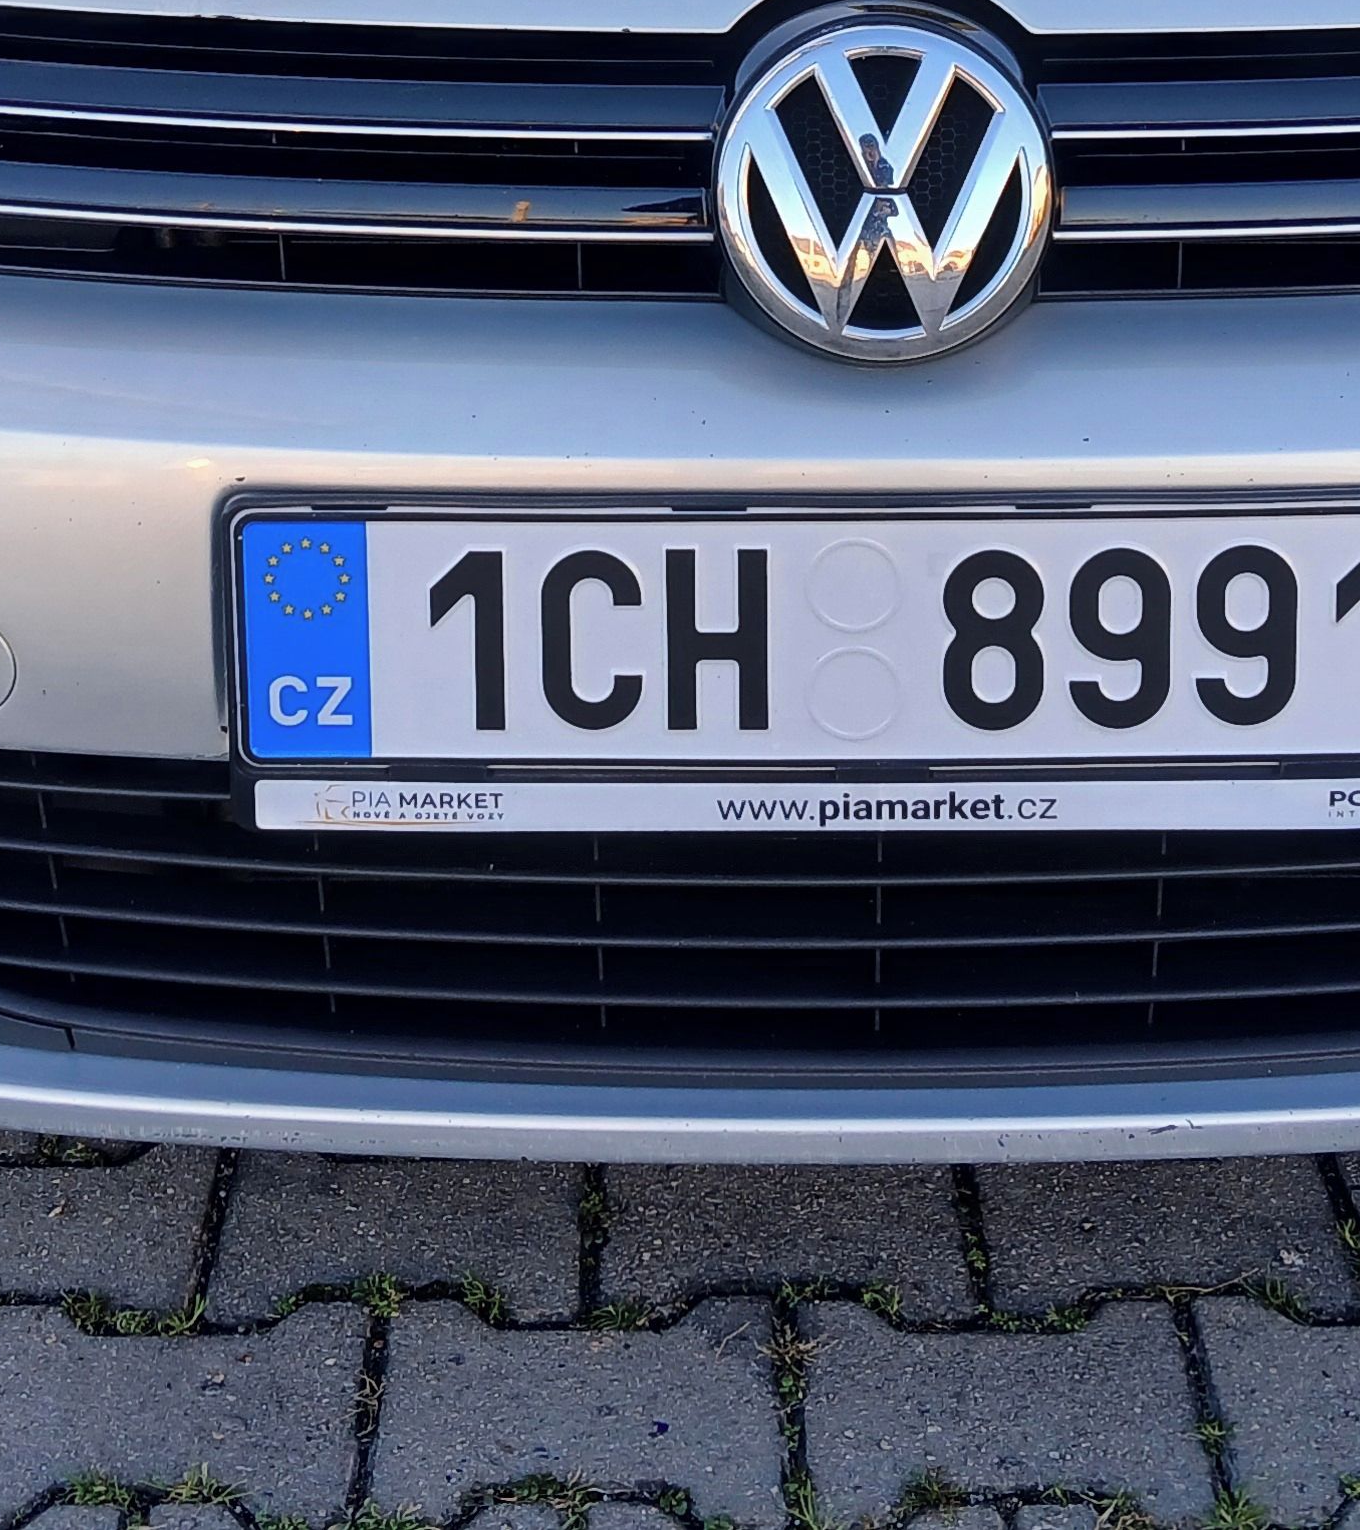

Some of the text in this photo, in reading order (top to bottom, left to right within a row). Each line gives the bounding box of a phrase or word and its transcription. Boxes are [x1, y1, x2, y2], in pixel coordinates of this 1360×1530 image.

[429, 547, 770, 731] 1CH
[268, 675, 355, 727] CZ
[351, 790, 504, 809] PIA MARKET
[352, 809, 391, 819] NOVÉ
[414, 811, 459, 820] OJETÉ
[717, 791, 1058, 827] www.piamarket.cz
